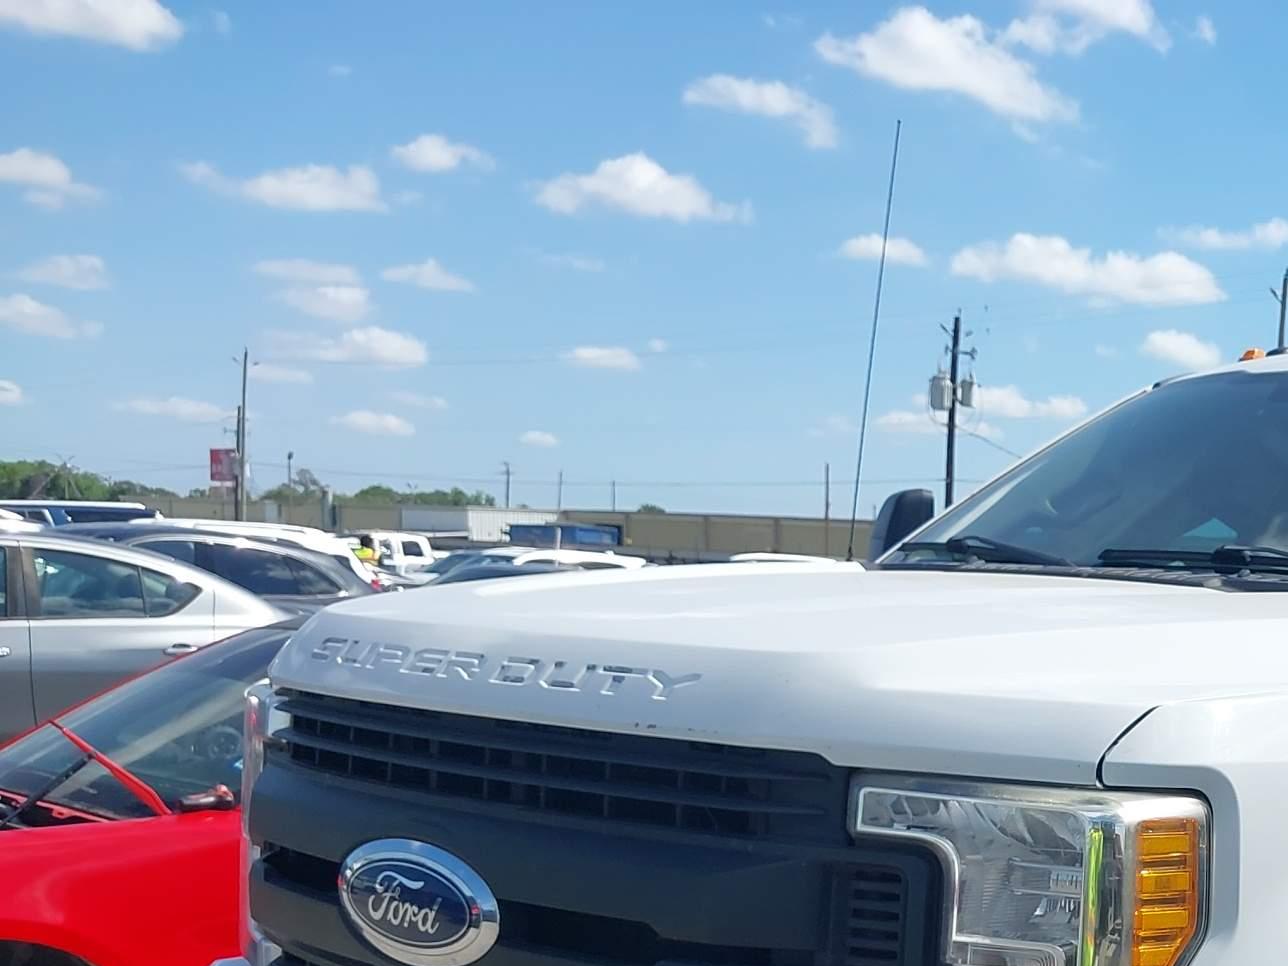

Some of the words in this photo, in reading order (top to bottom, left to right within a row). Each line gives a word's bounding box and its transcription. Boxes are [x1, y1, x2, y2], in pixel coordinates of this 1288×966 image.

[311, 636, 488, 681] SUPER
[488, 656, 703, 701] DUTY
[367, 871, 443, 935] Ford
